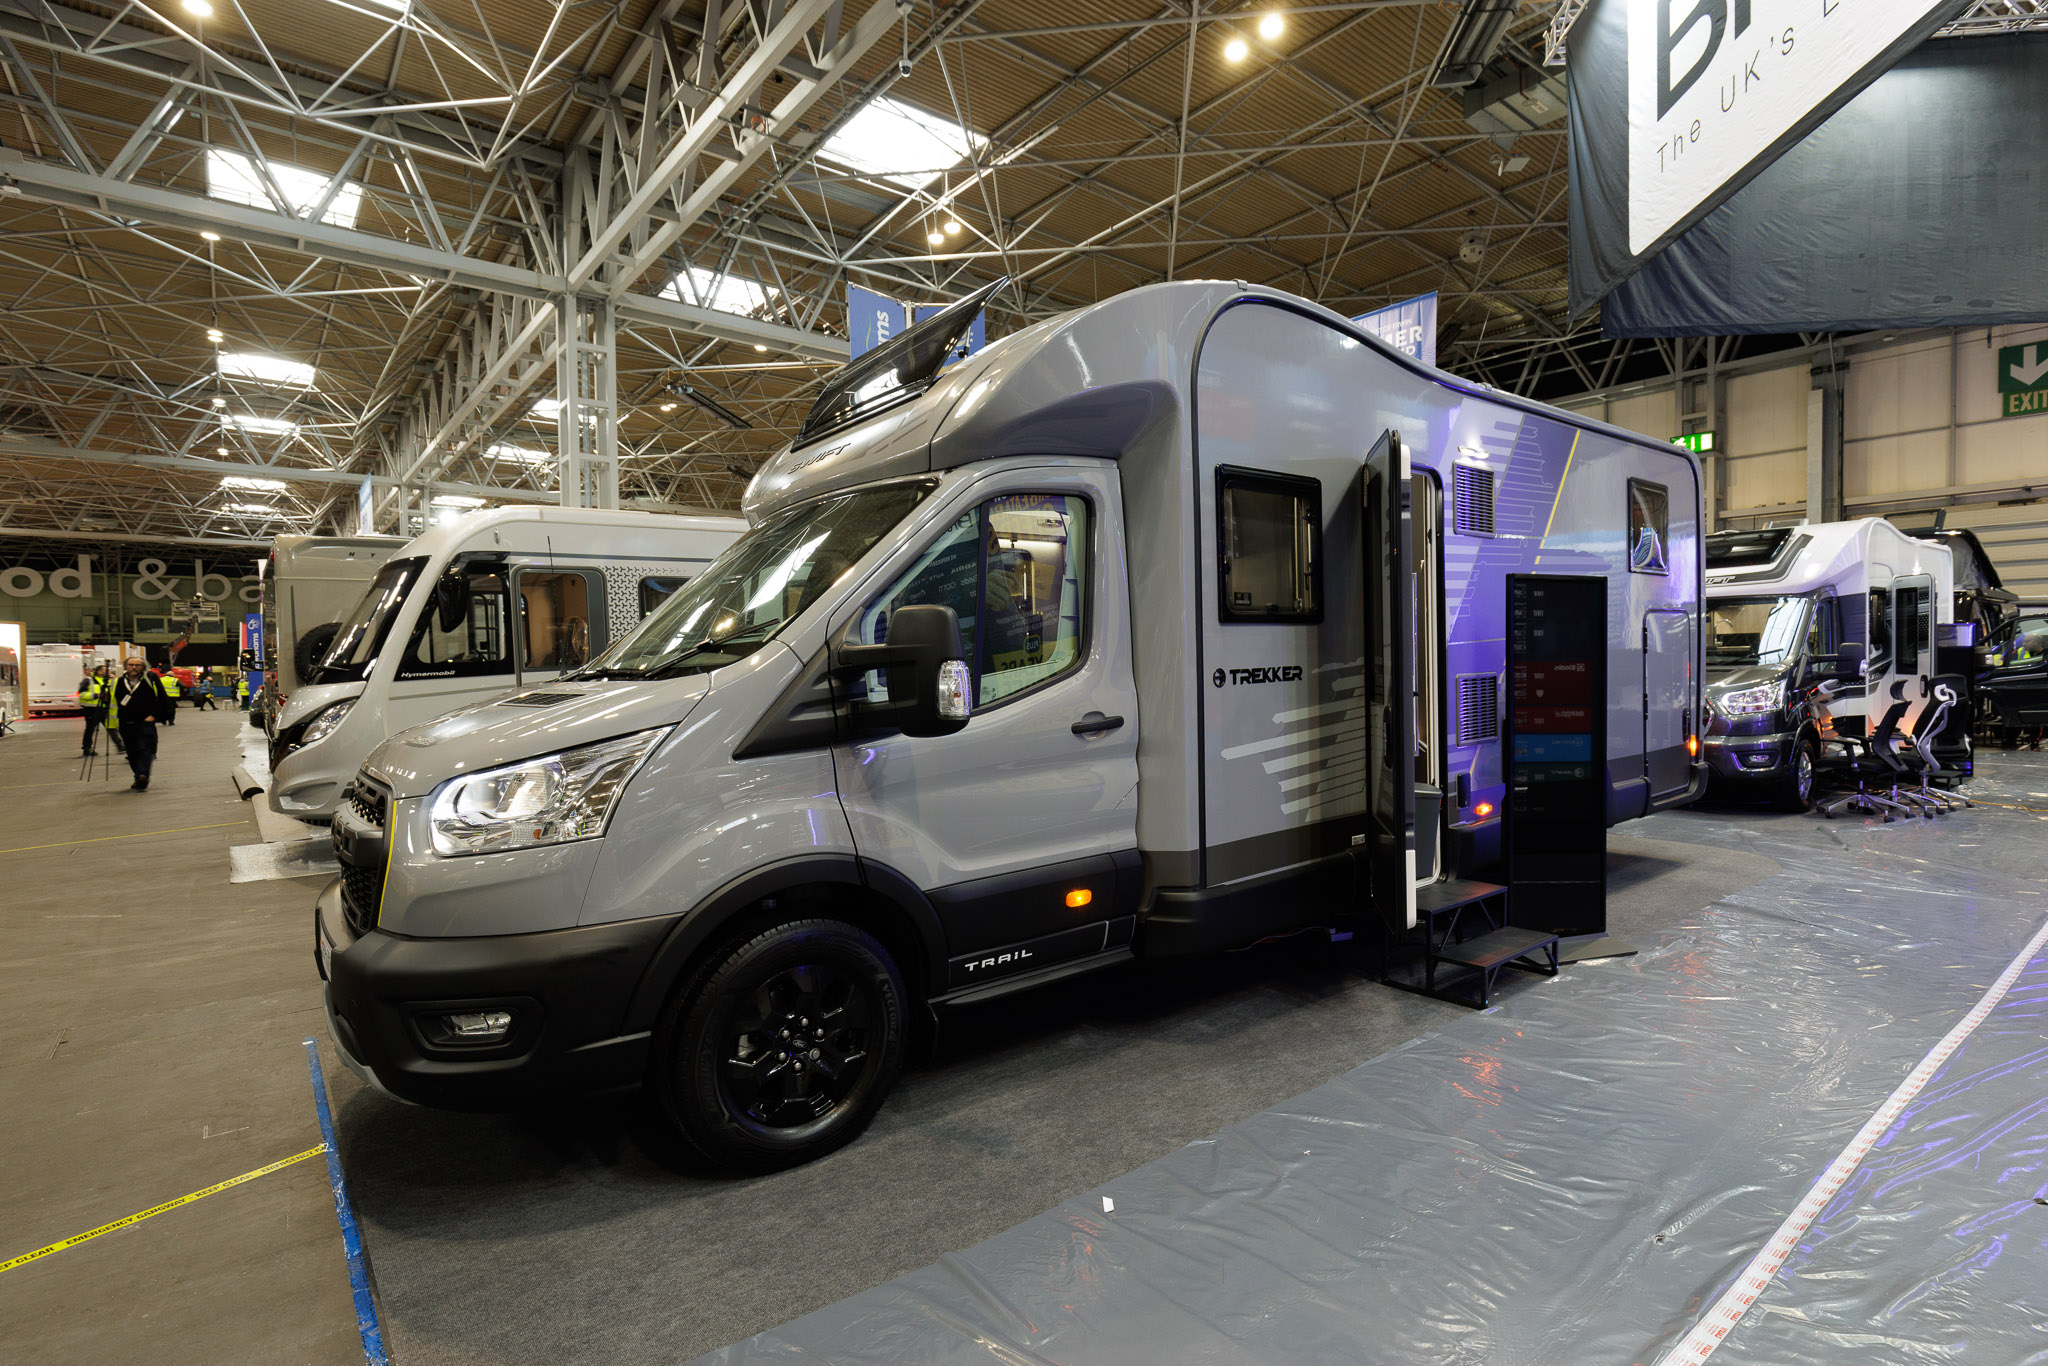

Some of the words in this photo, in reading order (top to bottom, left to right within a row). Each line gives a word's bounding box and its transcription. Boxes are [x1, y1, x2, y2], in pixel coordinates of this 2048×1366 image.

[1657, 119, 1700, 173] The
[1721, 26, 1795, 113] UK's
[2009, 389, 2048, 413] EXIT
[787, 442, 852, 475] SWIFT
[132, 558, 182, 601] &
[400, 670, 456, 679] Hymermobil
[1229, 665, 1303, 685] TREKKER
[964, 949, 1033, 971] TRAIL
[65, 1217, 133, 1245] EMERGENCY
[136, 1198, 187, 1220] GANGWAY
[195, 1185, 221, 1198] KEEP
[223, 1174, 254, 1187] CLEAR
[15, 1247, 55, 1264] CLEAR
